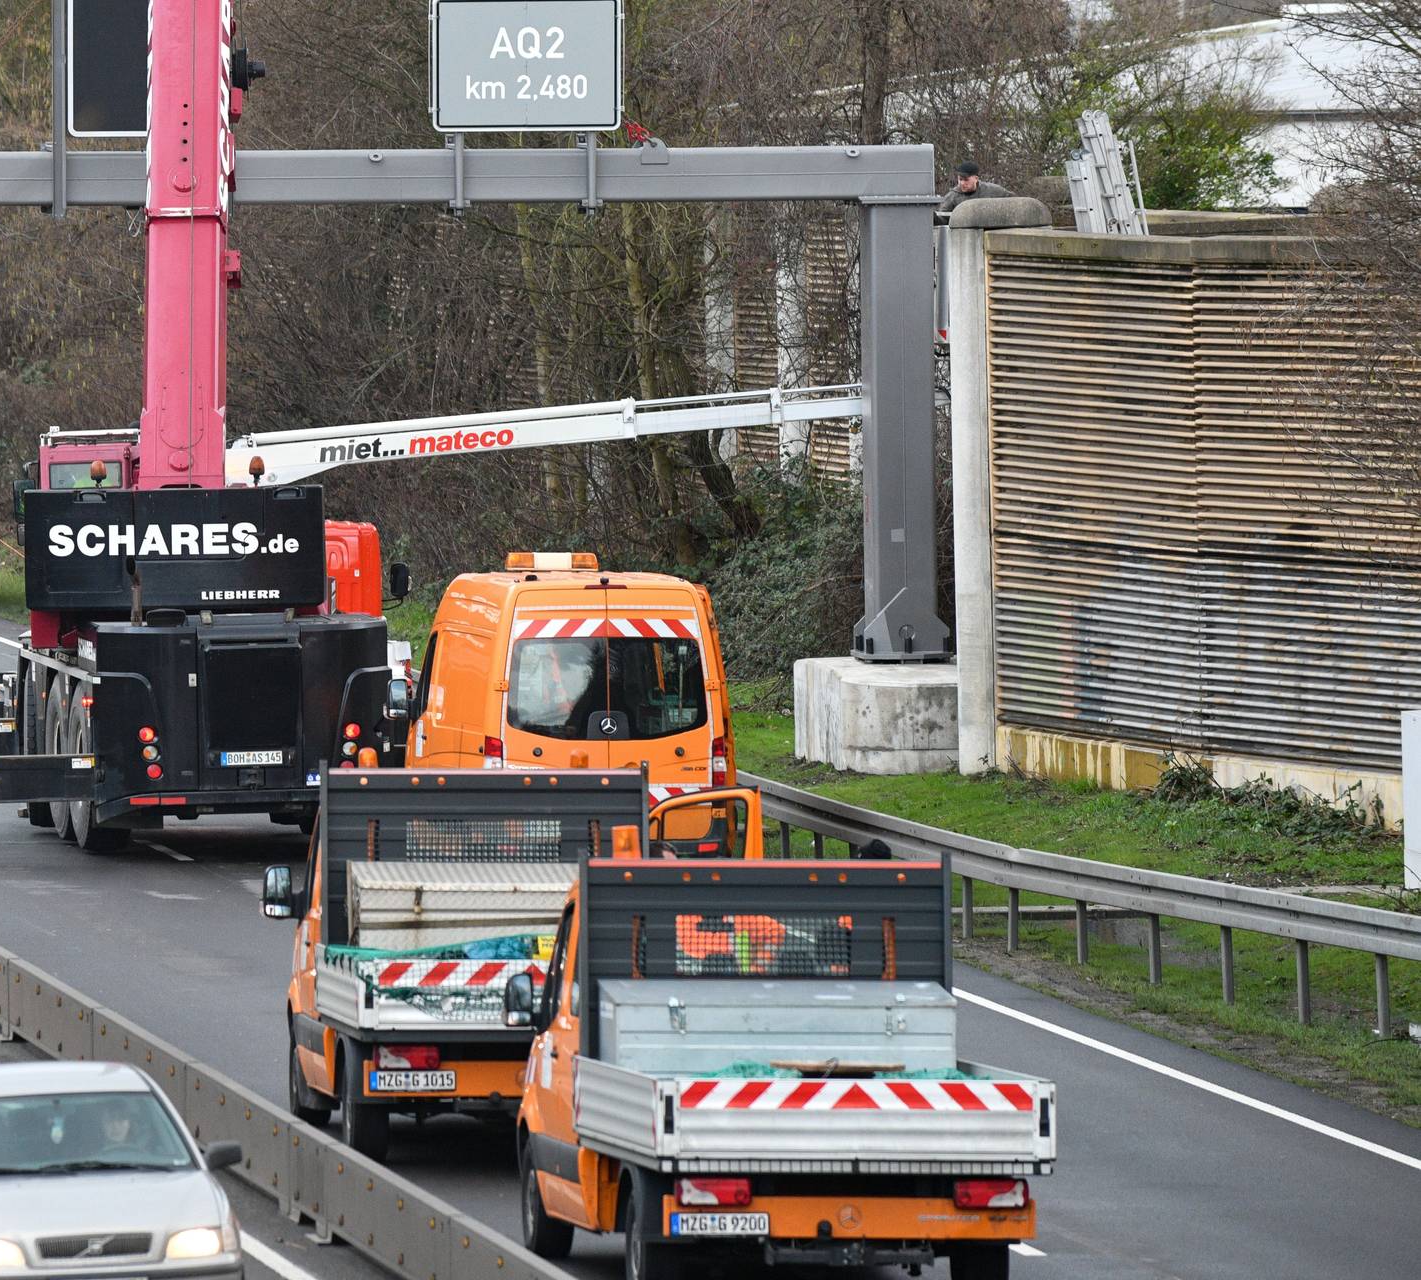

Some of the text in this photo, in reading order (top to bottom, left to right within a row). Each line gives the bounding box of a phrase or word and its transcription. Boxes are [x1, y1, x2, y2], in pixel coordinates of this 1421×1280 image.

[489, 26, 565, 59] AQ2
[465, 74, 588, 102] km 2,480
[409, 428, 514, 455] mateco
[48, 521, 300, 557] SCHARES.de
[201, 589, 280, 601] LIEBHERR
[227, 751, 282, 764] BOH AS 145
[378, 1073, 453, 1087] MZG G 1015
[680, 1216, 766, 1231] MZG G 9200
